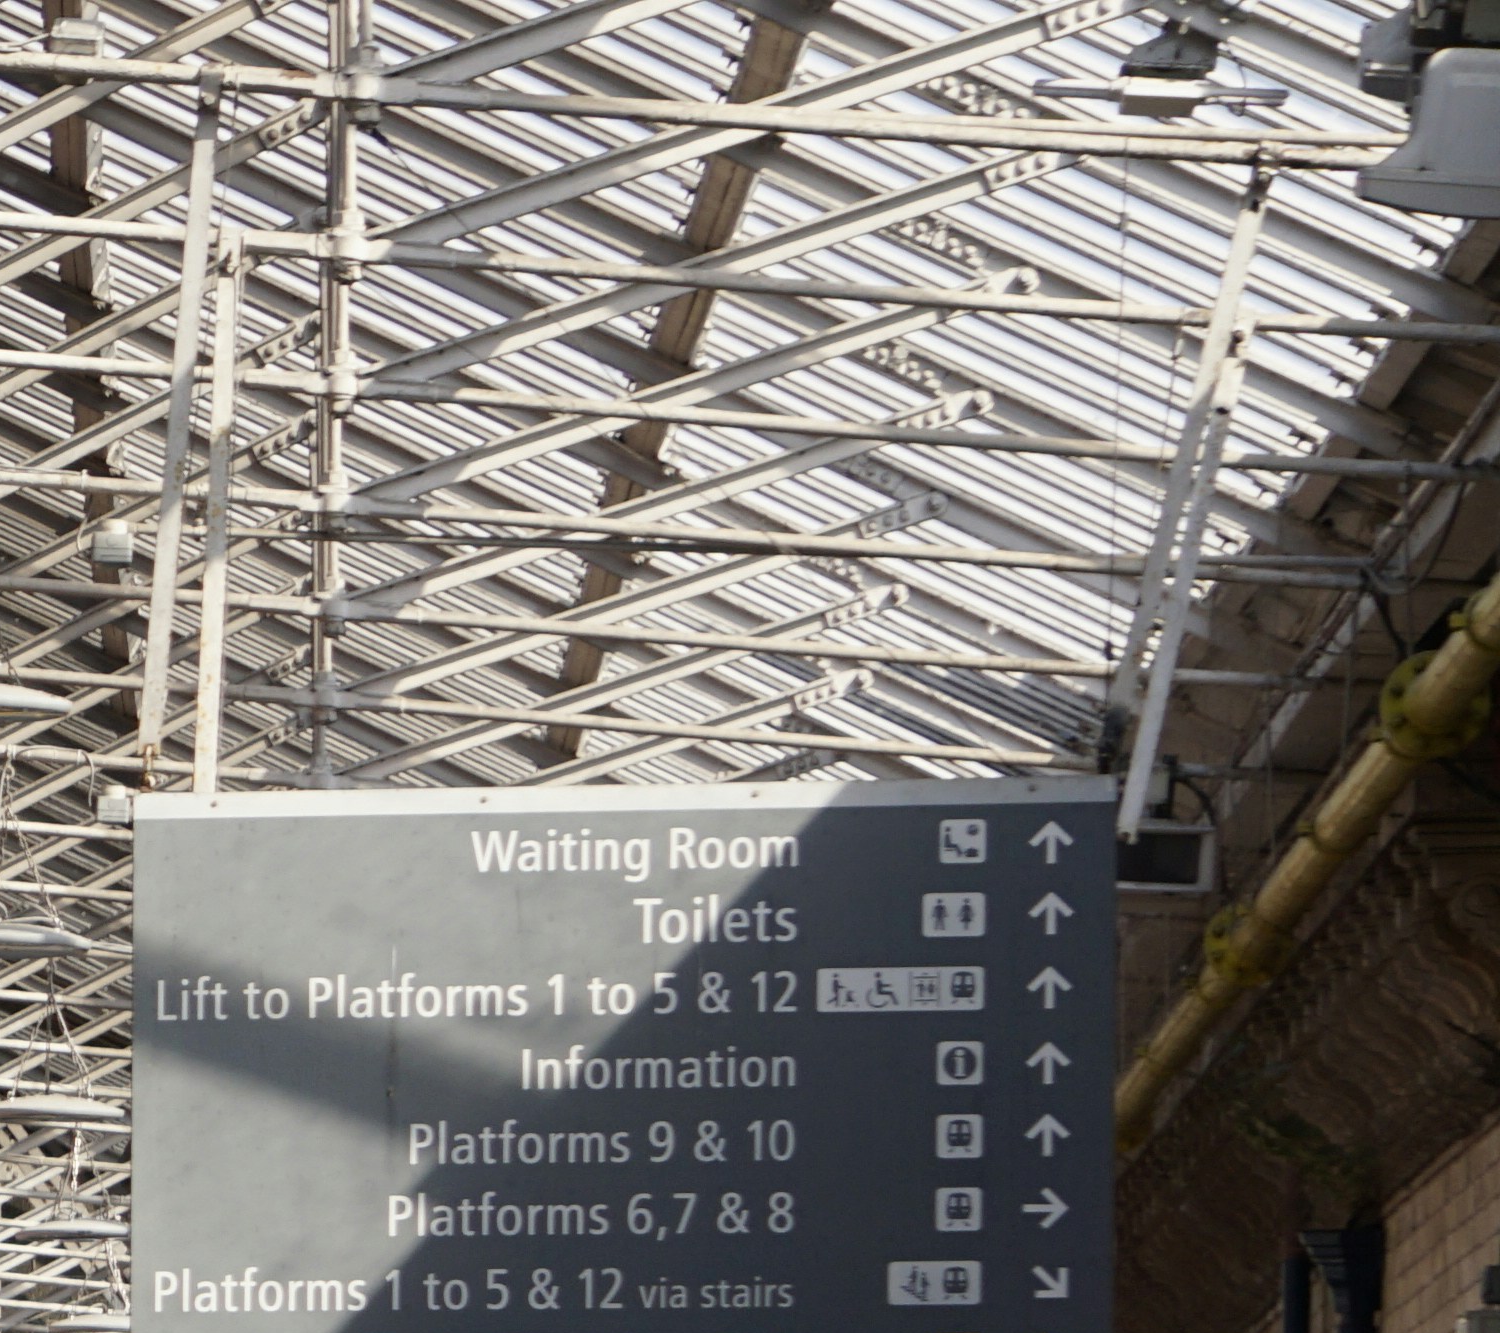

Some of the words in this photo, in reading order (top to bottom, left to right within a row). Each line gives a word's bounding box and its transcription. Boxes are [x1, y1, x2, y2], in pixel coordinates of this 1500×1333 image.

[471, 828, 650, 882] Waiting
[669, 828, 799, 869] Room
[633, 894, 797, 944] Toilets
[157, 976, 228, 1021] Lift
[243, 982, 289, 1019] to
[309, 973, 529, 1019] Platforms
[548, 974, 564, 1015] 1
[587, 977, 636, 1015] to
[654, 972, 678, 1014] 5
[698, 972, 731, 1013] &
[751, 971, 797, 1012] 12
[522, 1045, 796, 1090] Information
[410, 1119, 631, 1165] Platforms
[649, 1121, 675, 1162] 9
[694, 1121, 727, 1162] &
[747, 1120, 795, 1161] 10
[389, 1191, 609, 1236] Platforms
[627, 1193, 697, 1241] 6,7
[717, 1192, 750, 1234] &
[768, 1192, 794, 1233] 8
[155, 1267, 366, 1312] Platforms
[386, 1270, 400, 1311] 1
[423, 1273, 469, 1310] to
[487, 1269, 510, 1310] 5
[528, 1268, 560, 1310] &
[579, 1268, 623, 1309] 12
[639, 1277, 688, 1309] via
[700, 1276, 794, 1308] stairs
